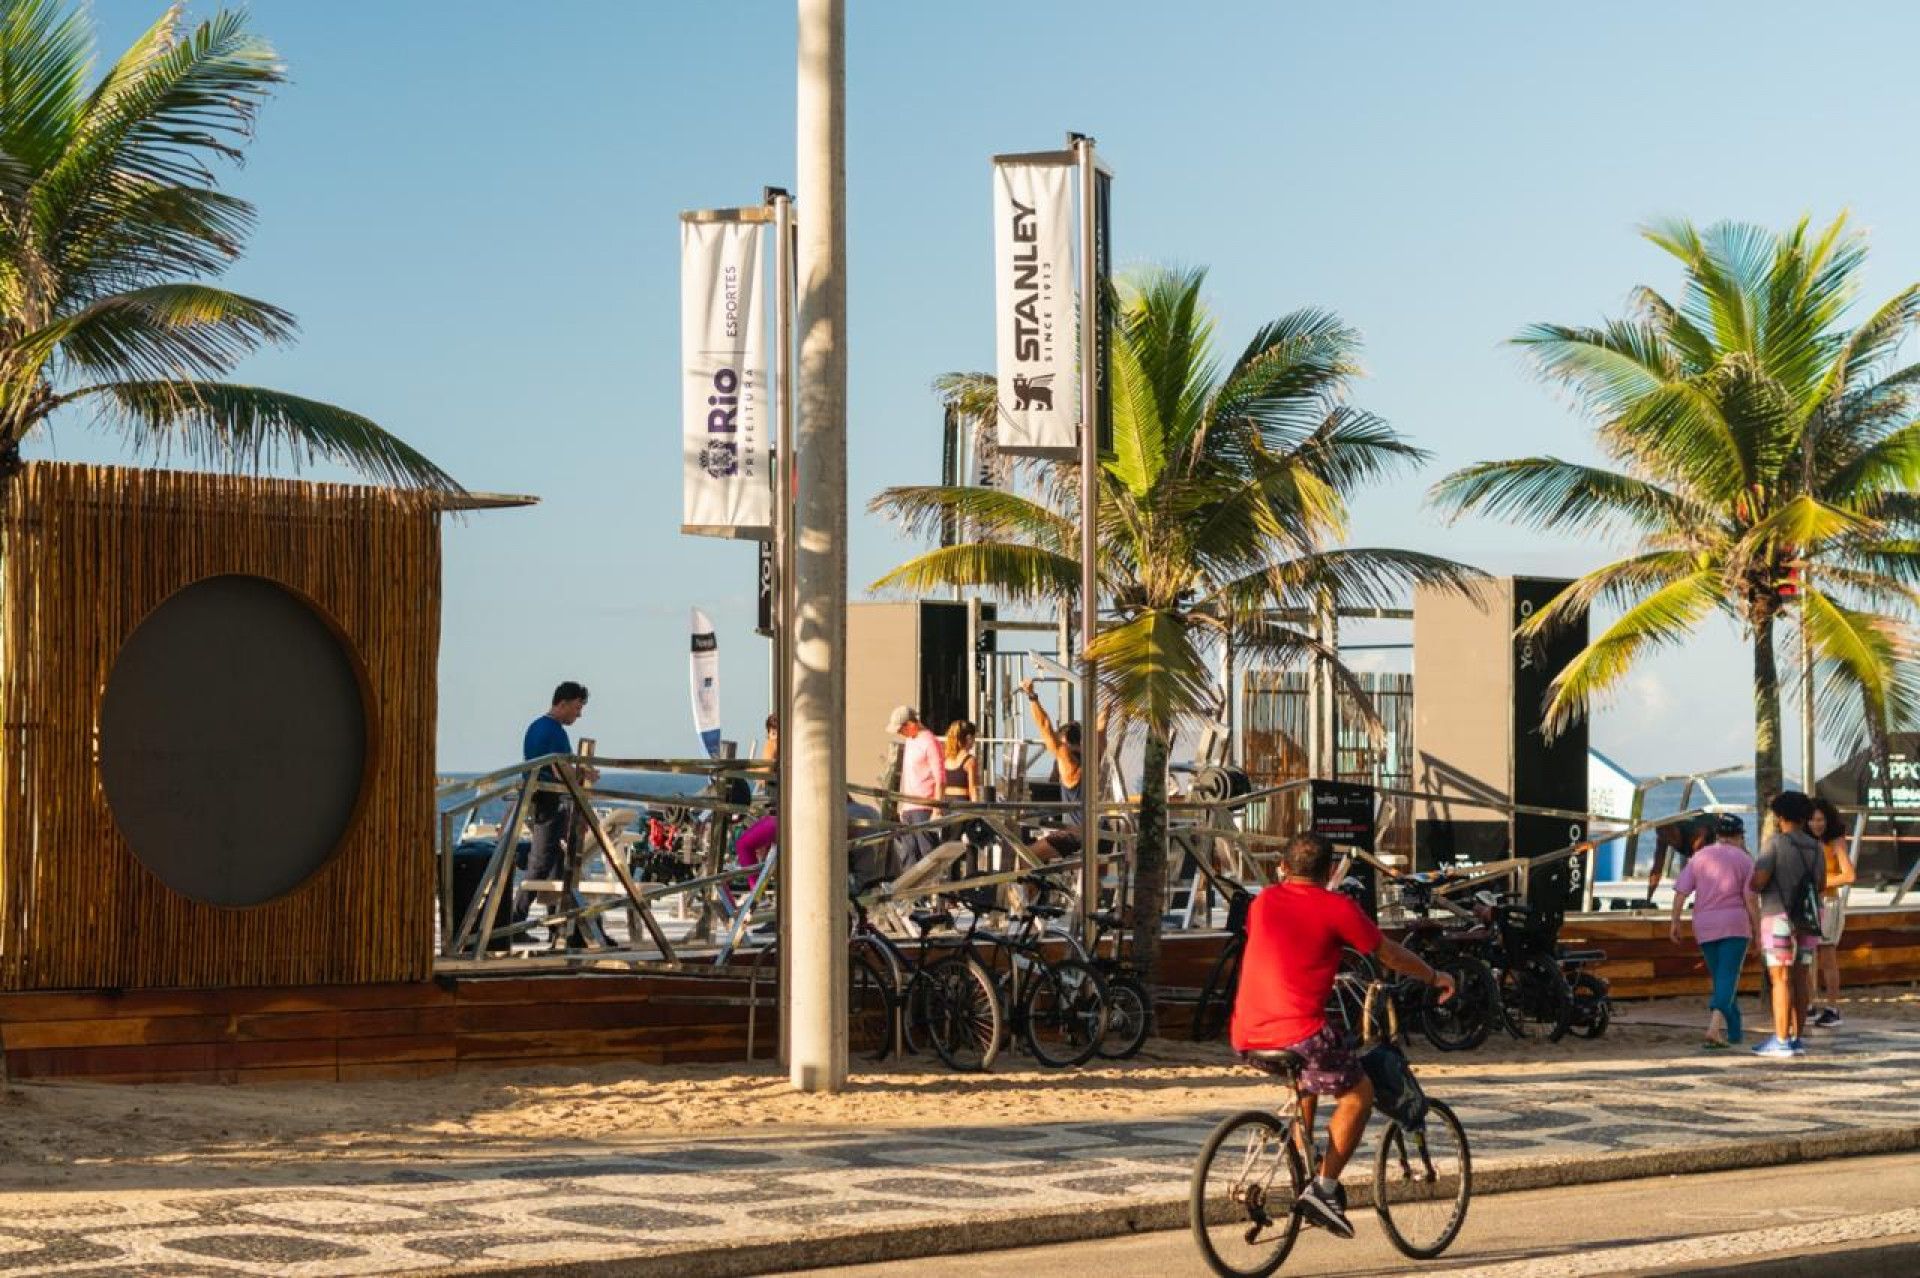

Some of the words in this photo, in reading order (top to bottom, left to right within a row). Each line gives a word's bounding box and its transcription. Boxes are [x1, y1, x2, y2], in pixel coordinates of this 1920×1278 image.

[726, 265, 737, 338] ESPORTES
[1011, 198, 1041, 363] STANLEY
[1043, 262, 1052, 301] 1913
[1044, 311, 1053, 363] SINCE
[707, 368, 738, 434] Rio
[745, 368, 755, 478] PREFEITURA
[1569, 824, 1581, 894] YoPO
